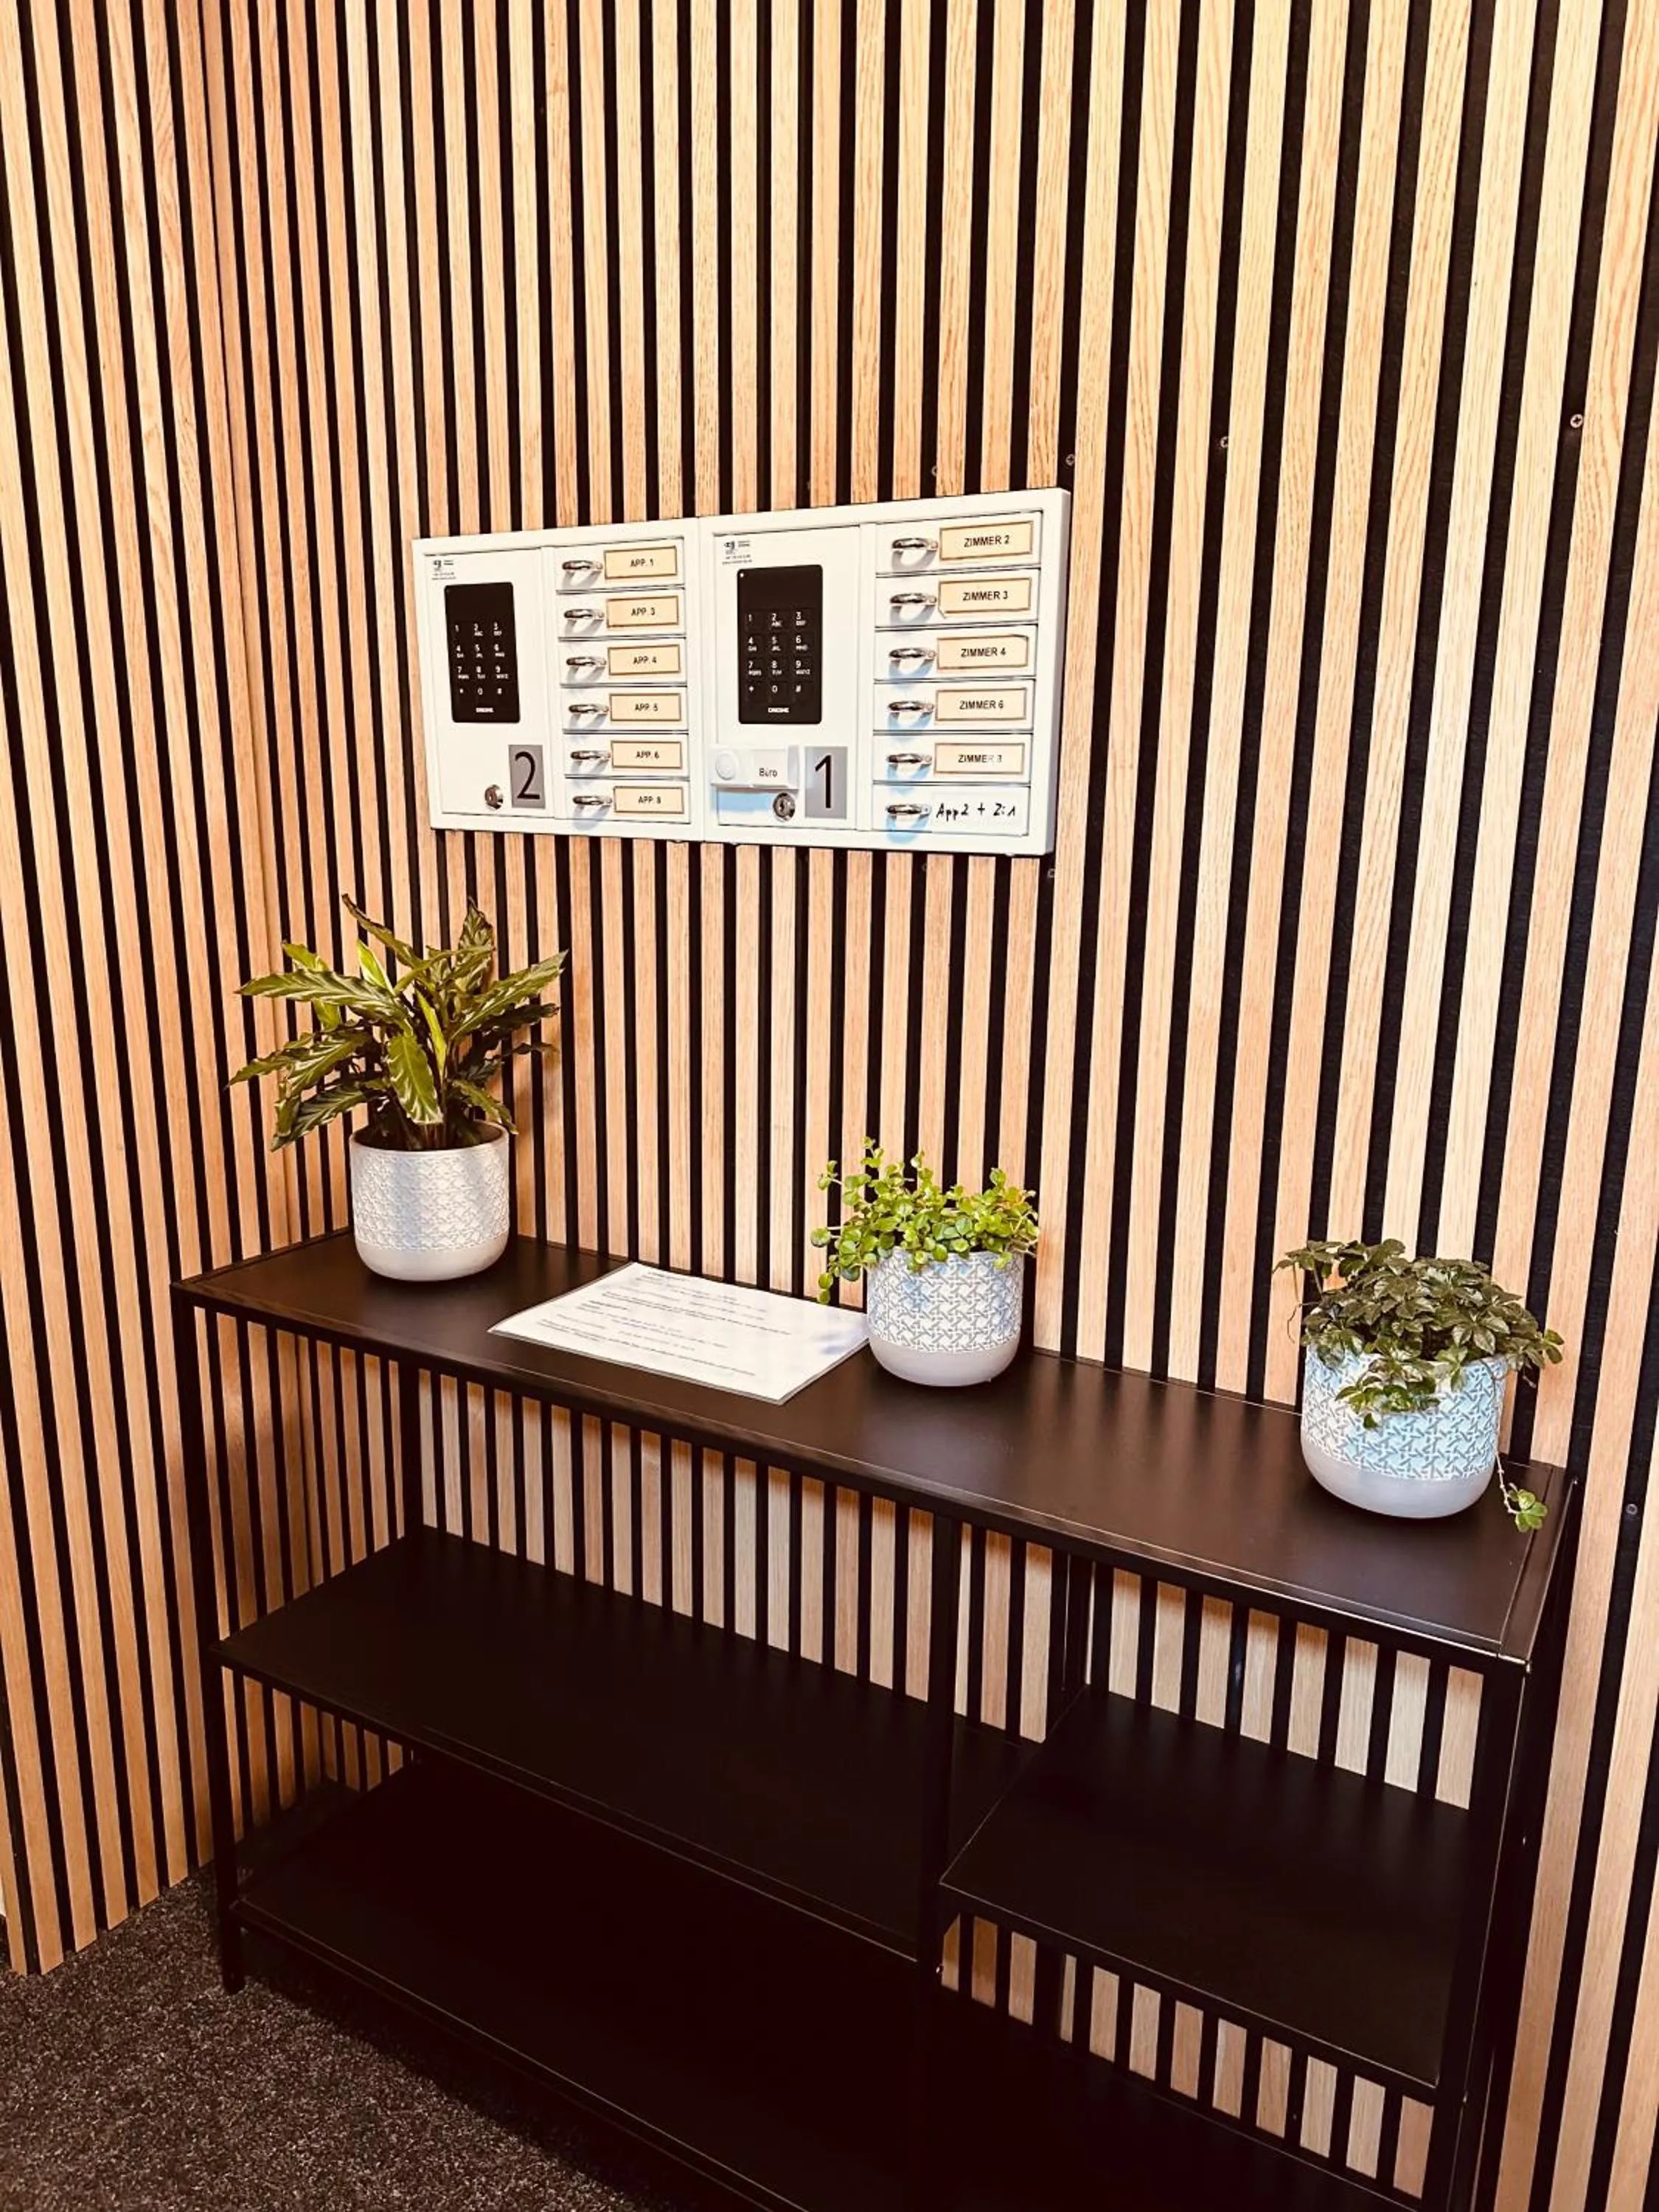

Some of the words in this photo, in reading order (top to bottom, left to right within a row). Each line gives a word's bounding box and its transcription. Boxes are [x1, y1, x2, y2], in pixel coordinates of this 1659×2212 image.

[964, 535, 1002, 548] ZIMMER
[1004, 535, 1010, 545] 2
[962, 591, 1001, 601] ZIMMER
[1003, 591, 1009, 599] 3
[651, 607, 655, 616] 3
[796, 611, 801, 619] 3
[796, 635, 801, 644] 6
[961, 647, 998, 658] ZIMMER
[999, 647, 1006, 656] 4
[652, 655, 657, 664] 4
[796, 660, 801, 669] 9
[653, 703, 658, 712] 5
[959, 700, 996, 709] ZIMMER
[998, 700, 1004, 709] 6
[654, 751, 660, 759] 6
[958, 754, 994, 763] ZIMMER
[515, 751, 540, 799] 2
[815, 754, 832, 808] 1
[977, 802, 985, 815] +
